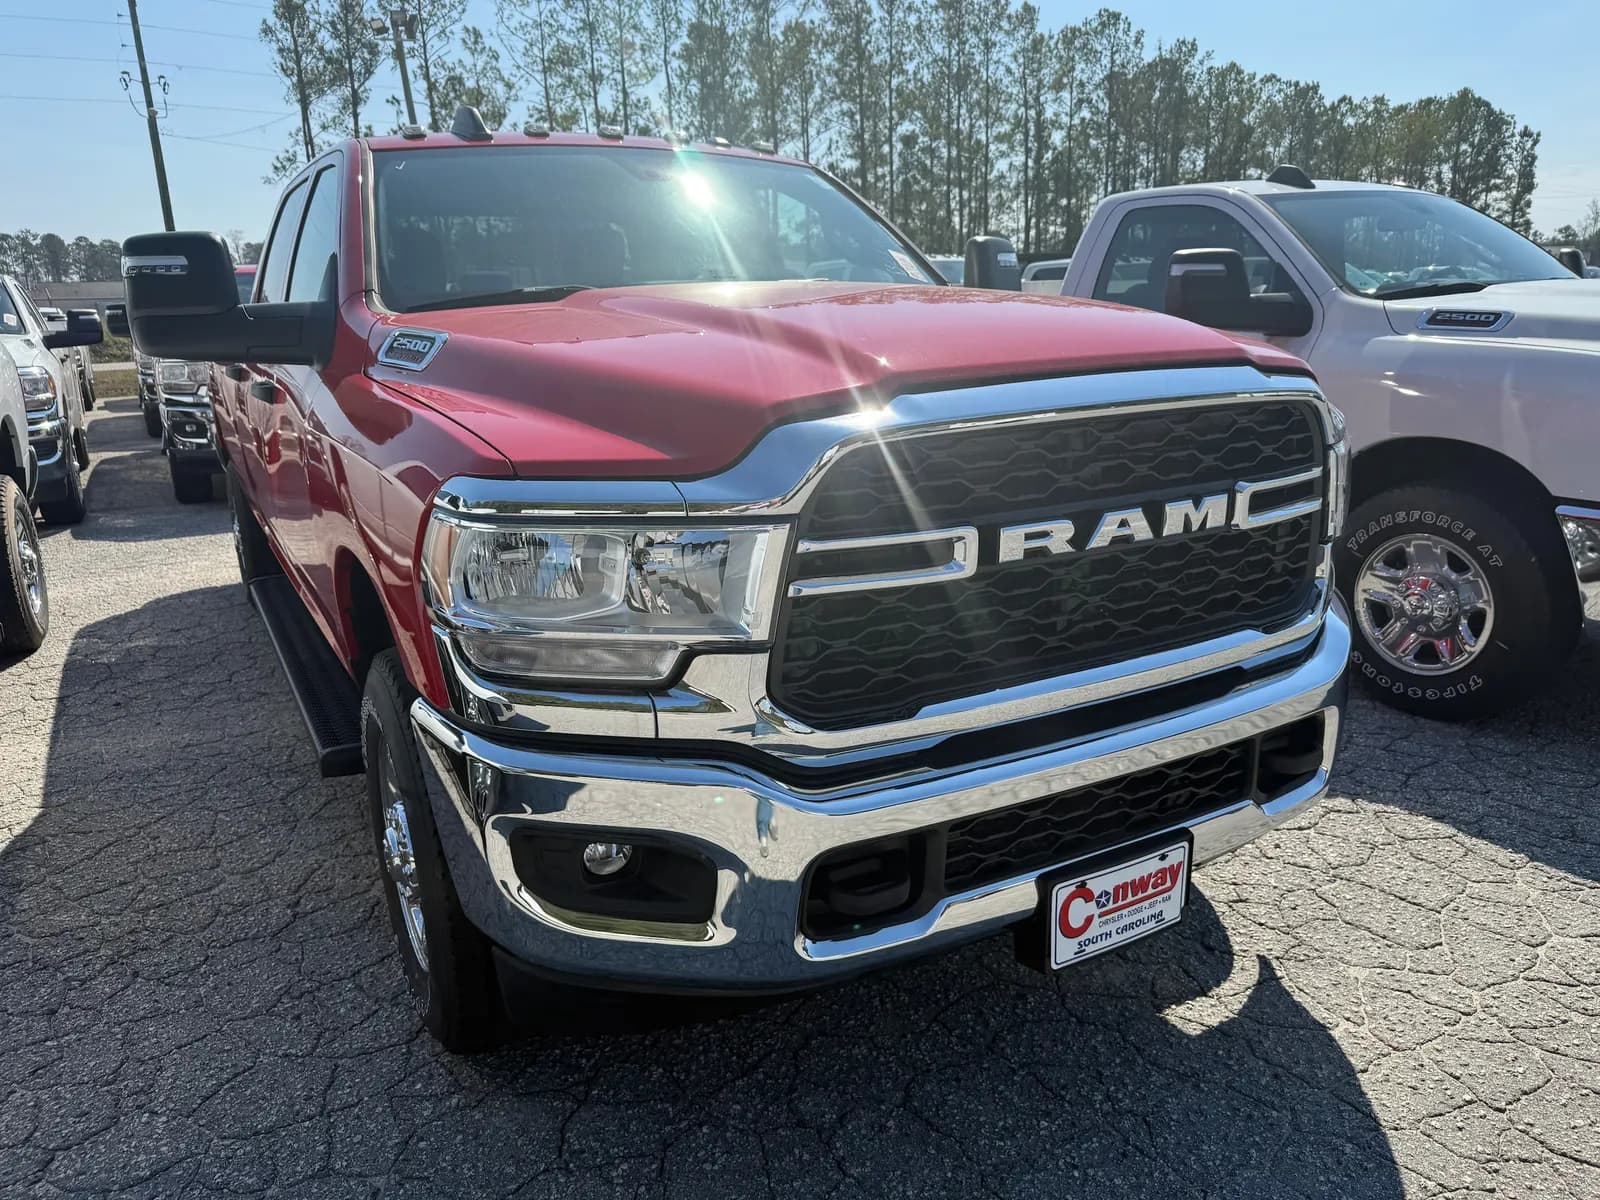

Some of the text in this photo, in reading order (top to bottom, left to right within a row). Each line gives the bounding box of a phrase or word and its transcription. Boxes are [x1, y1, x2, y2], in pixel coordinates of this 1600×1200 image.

[1436, 312, 1496, 321] 2500
[392, 337, 432, 353] 2500
[999, 493, 1229, 563] RAM
[1347, 510, 1503, 568] TRANSFORCE AT
[1058, 860, 1184, 940] Conway
[1098, 913, 1124, 928] CHRYSLER
[1127, 905, 1144, 917] DODGE
[1146, 899, 1159, 911] JEEP
[1076, 909, 1164, 950] SOUTH CAROLINA
